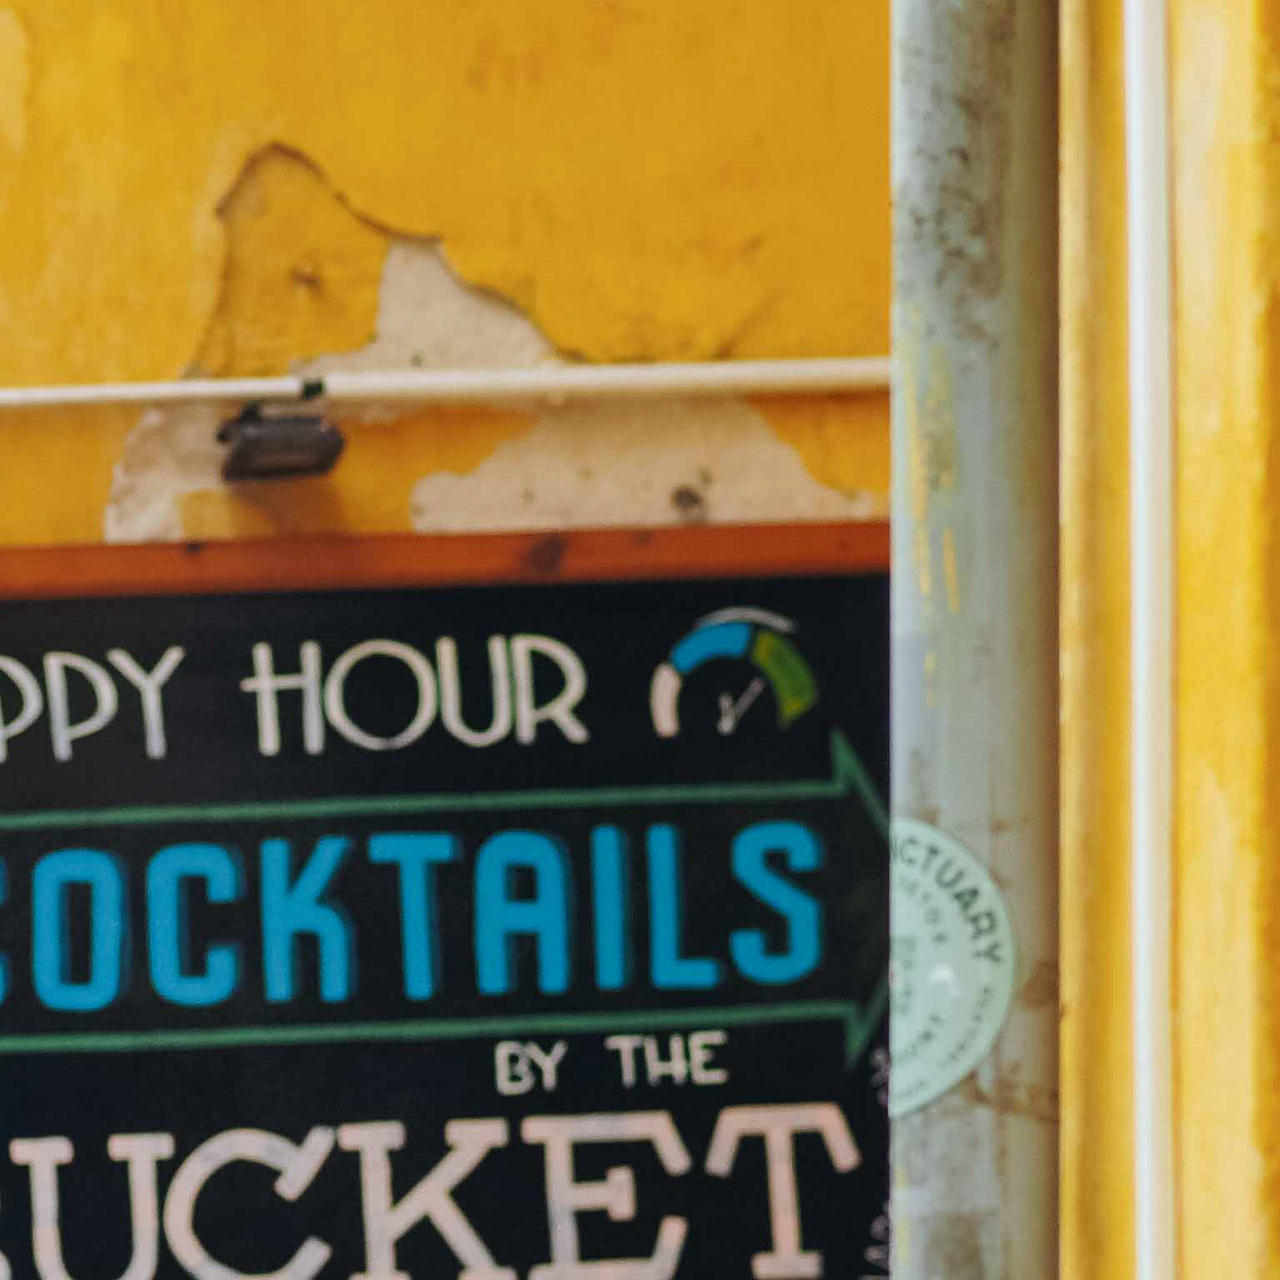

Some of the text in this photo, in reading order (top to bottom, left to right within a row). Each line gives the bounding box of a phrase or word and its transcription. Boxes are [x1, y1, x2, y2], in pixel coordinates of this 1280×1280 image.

[242, 635, 586, 755] HOUR
[890, 834, 1001, 964] CTUARY
[495, 1031, 726, 1094] BY THE
